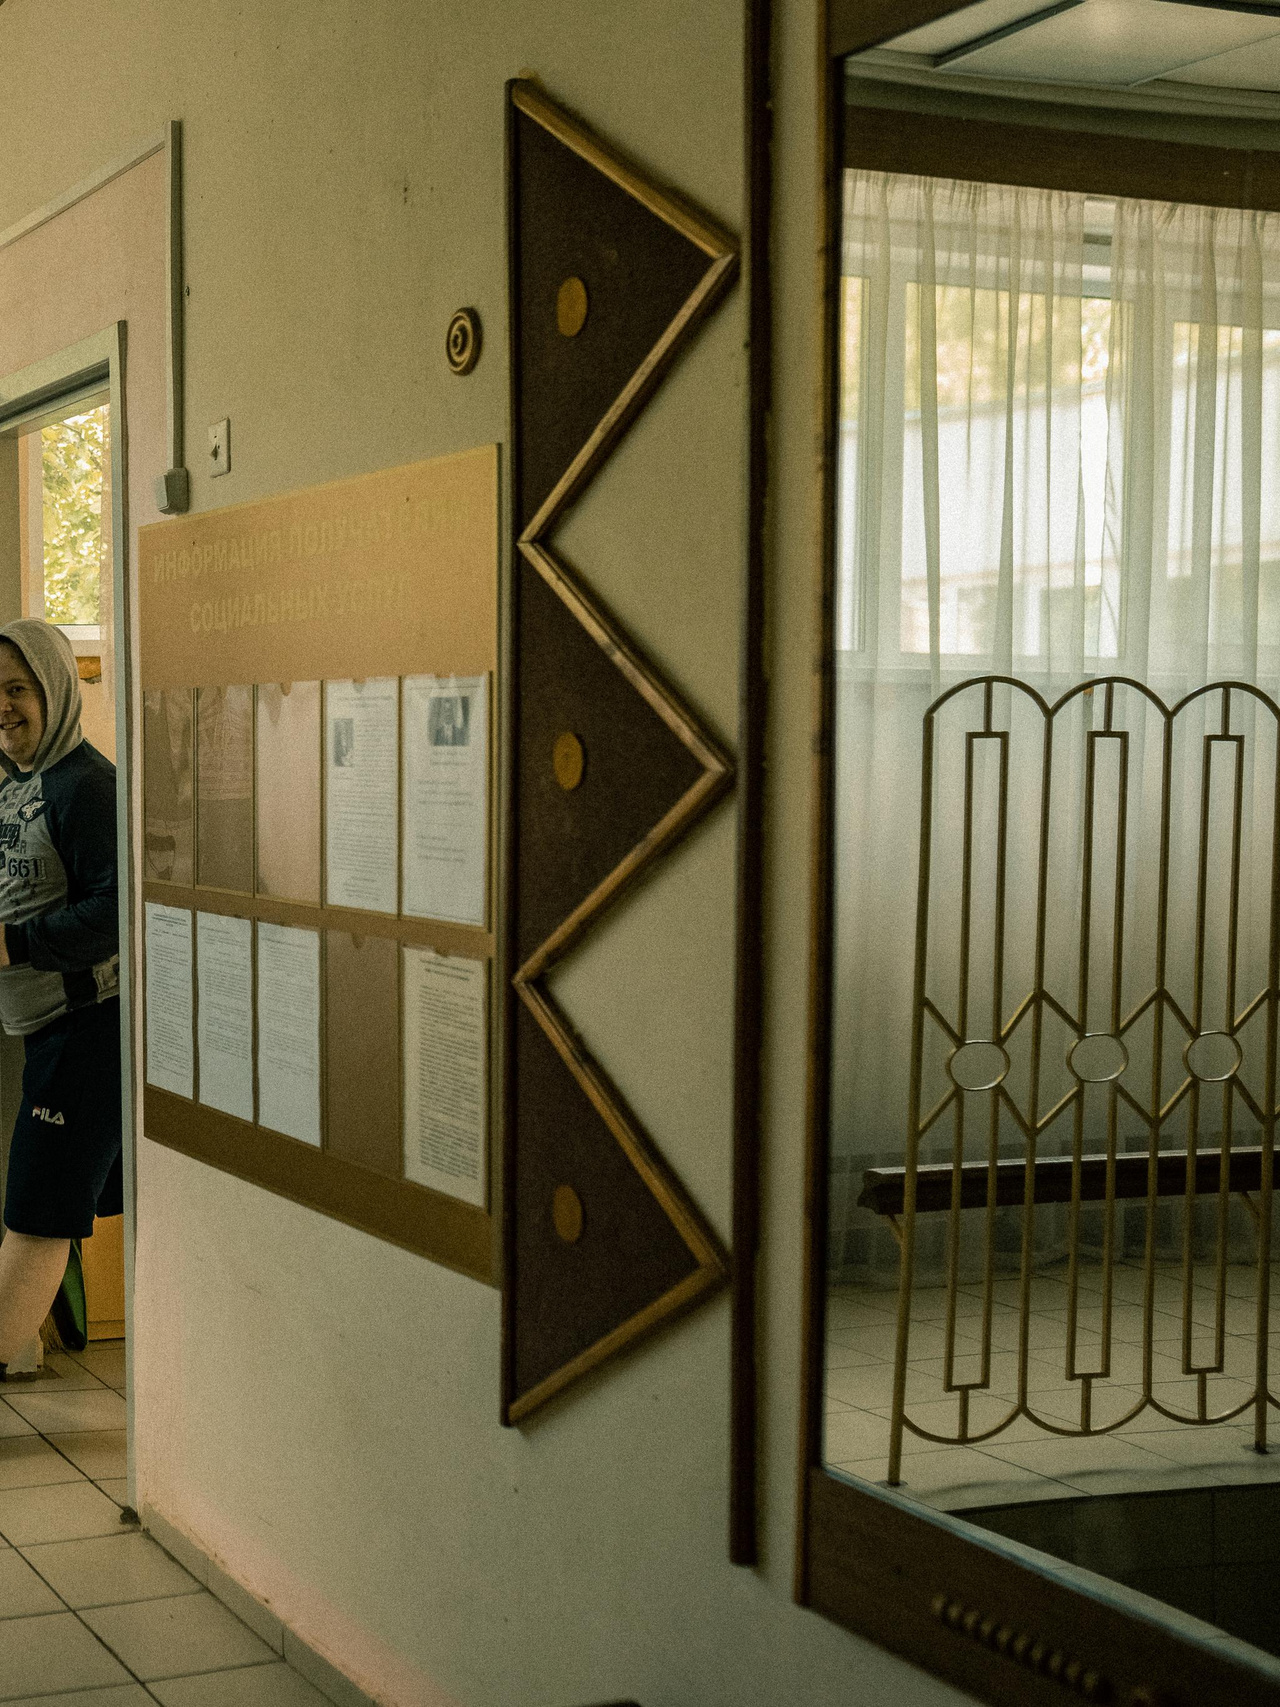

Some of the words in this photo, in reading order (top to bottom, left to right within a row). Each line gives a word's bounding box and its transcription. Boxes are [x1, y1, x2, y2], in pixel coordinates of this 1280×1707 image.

[153, 530, 280, 583] ИНФОРМАЦИЯ
[190, 582, 329, 634] СОЦИАЛЬНЫХ
[32, 1106, 65, 1125] FILA
